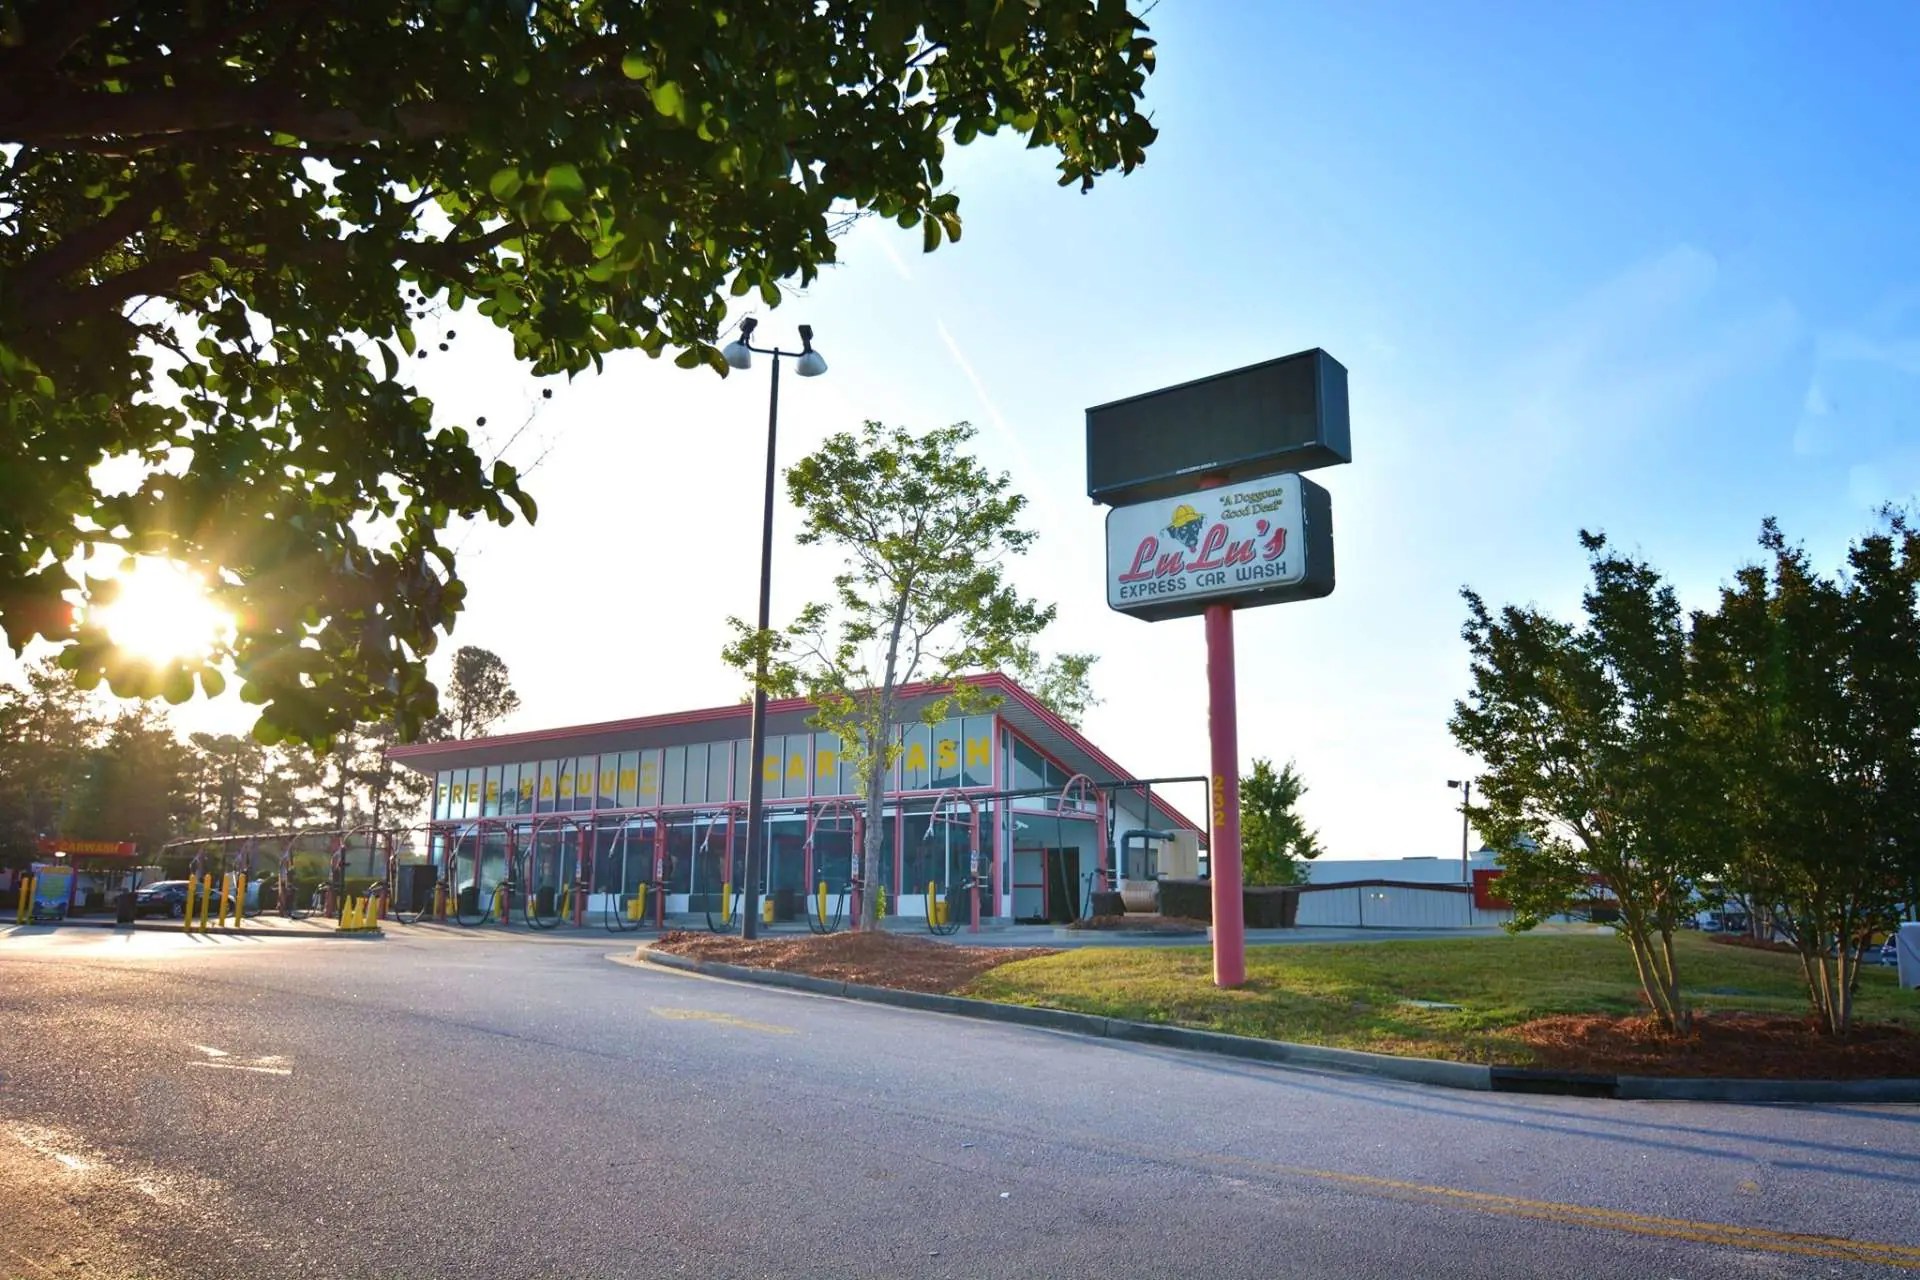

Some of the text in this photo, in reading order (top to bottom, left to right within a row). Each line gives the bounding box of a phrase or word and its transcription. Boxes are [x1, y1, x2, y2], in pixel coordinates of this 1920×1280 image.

[1221, 504, 1252, 520] Good
[1120, 562, 1287, 599] EXPRESS CAR WASH
[763, 735, 991, 782] CAR ASH
[438, 781, 498, 804] FREE
[1214, 775, 1225, 826] 232
